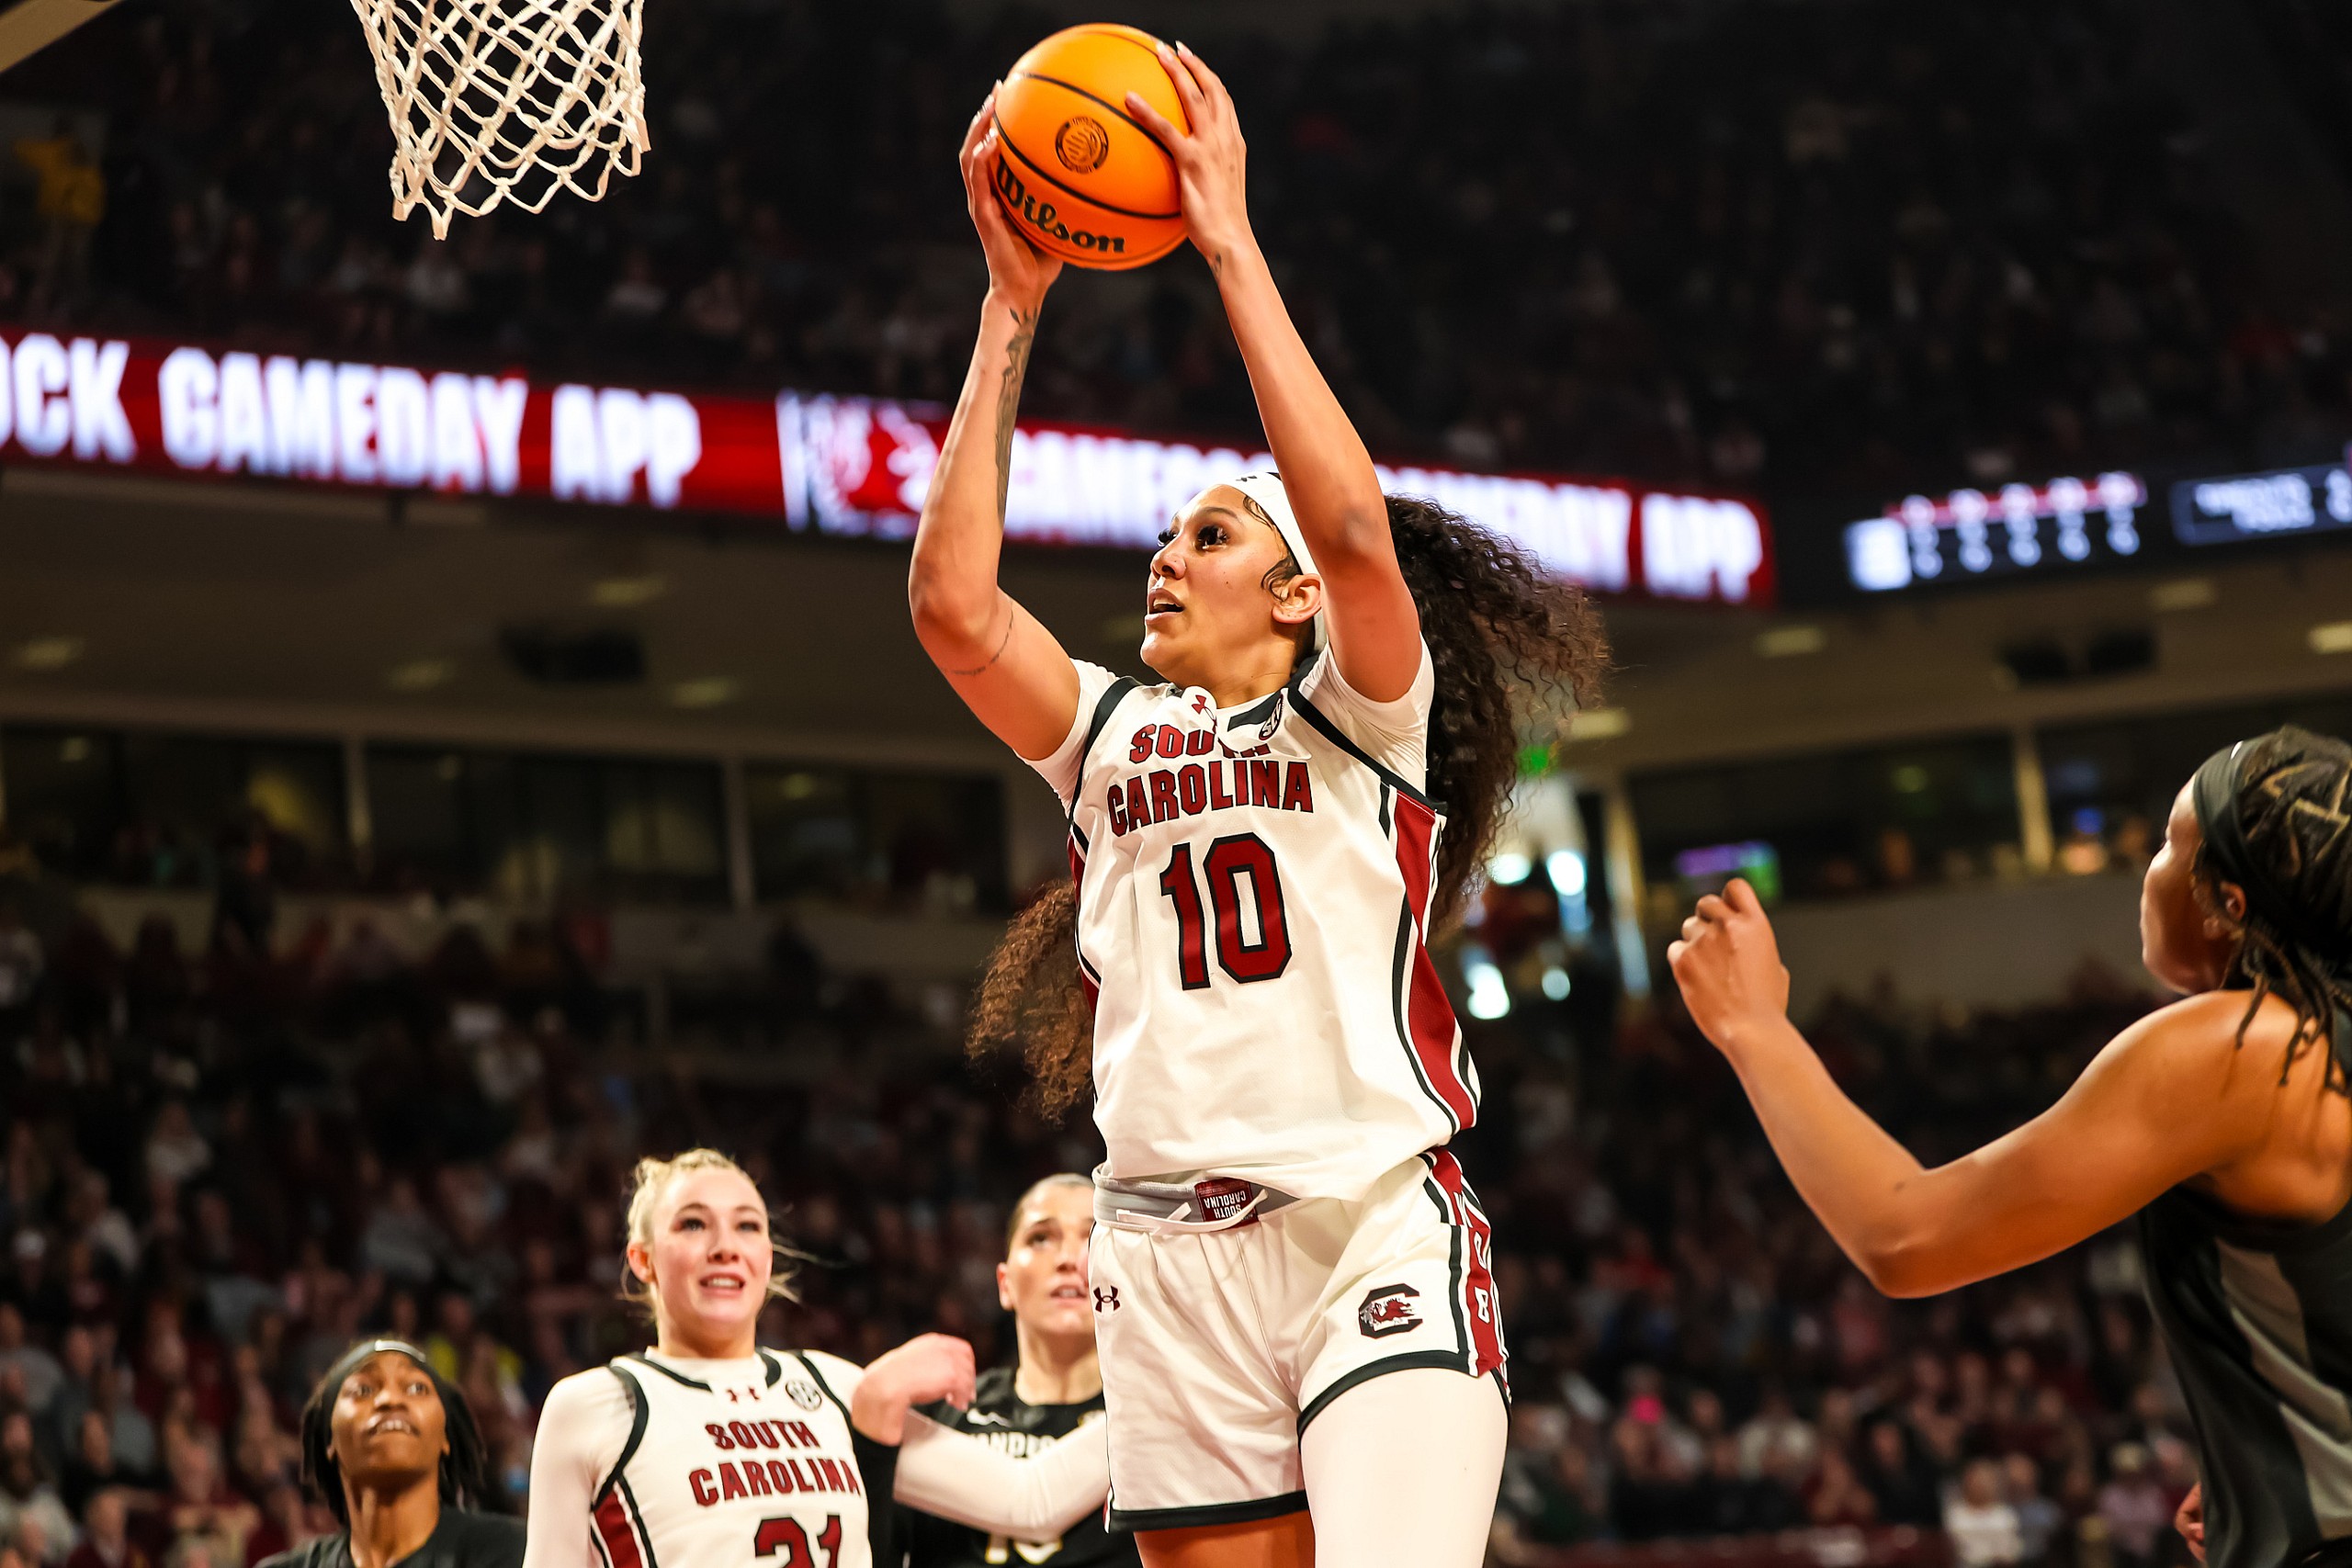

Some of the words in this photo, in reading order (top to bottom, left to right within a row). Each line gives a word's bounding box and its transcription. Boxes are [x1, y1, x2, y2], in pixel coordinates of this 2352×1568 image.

[996, 154, 1125, 254] Wilson
[0, 333, 137, 464] CK
[158, 345, 529, 496] GAMEDAY
[551, 383, 702, 508] APP
[1107, 760, 1314, 837] CAROLINA
[1159, 832, 1292, 990] 10
[1204, 1190, 1247, 1209] CAROLINA
[1213, 1203, 1242, 1219] SOUTH
[705, 1419, 820, 1450] SOUTH
[689, 1457, 861, 1506] CAROLINA
